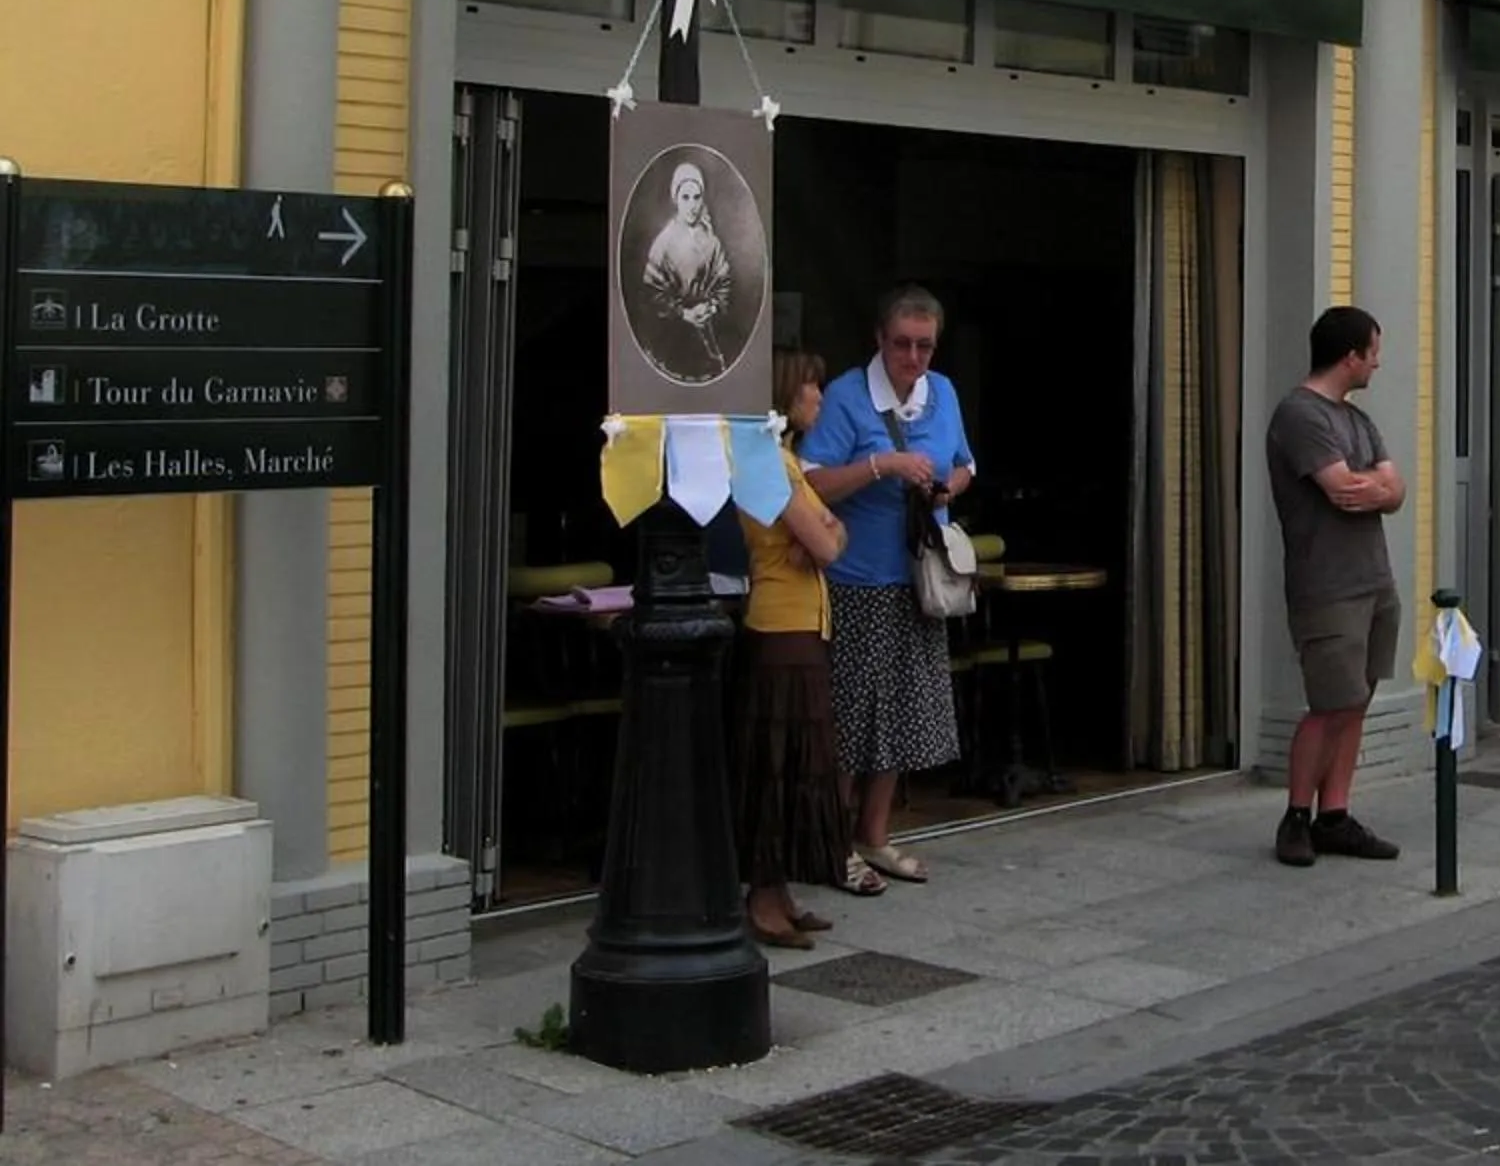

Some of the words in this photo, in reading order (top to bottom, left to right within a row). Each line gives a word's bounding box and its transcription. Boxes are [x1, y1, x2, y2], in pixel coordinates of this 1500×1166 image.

[91, 303, 126, 331] La
[136, 303, 221, 332] Grotte
[87, 376, 153, 405] Tour
[161, 376, 194, 405] du
[87, 451, 135, 480] Les
[144, 448, 234, 481] Halles,
[244, 446, 335, 474] Marché
